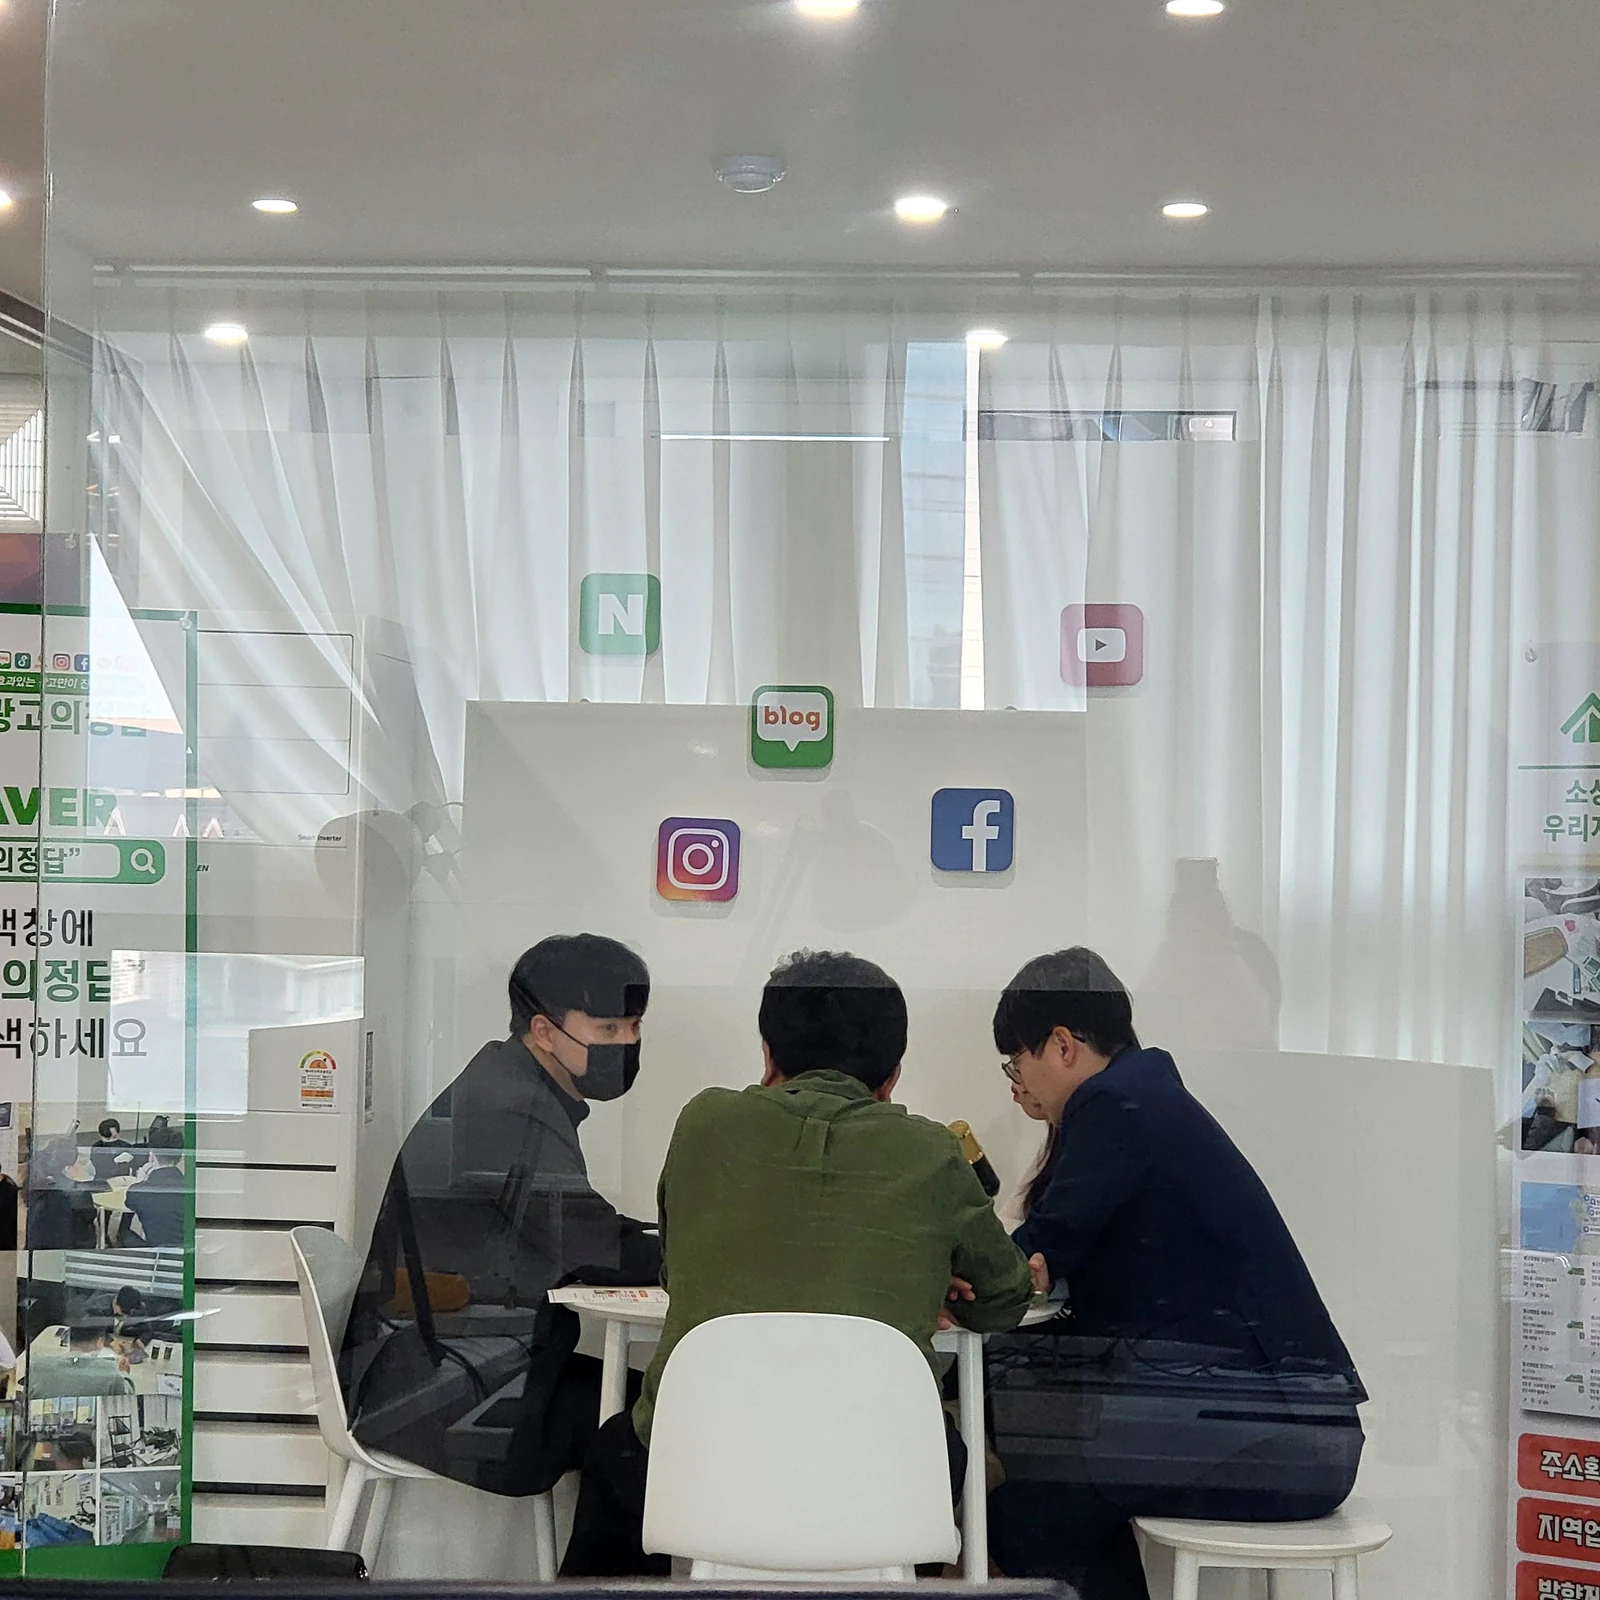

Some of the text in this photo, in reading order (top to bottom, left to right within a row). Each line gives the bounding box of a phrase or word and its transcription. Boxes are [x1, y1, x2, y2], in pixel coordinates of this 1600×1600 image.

[598, 594, 644, 635] N
[44, 677, 78, 689] 고만이
[764, 705, 820, 731] blog
[962, 799, 1000, 871] f
